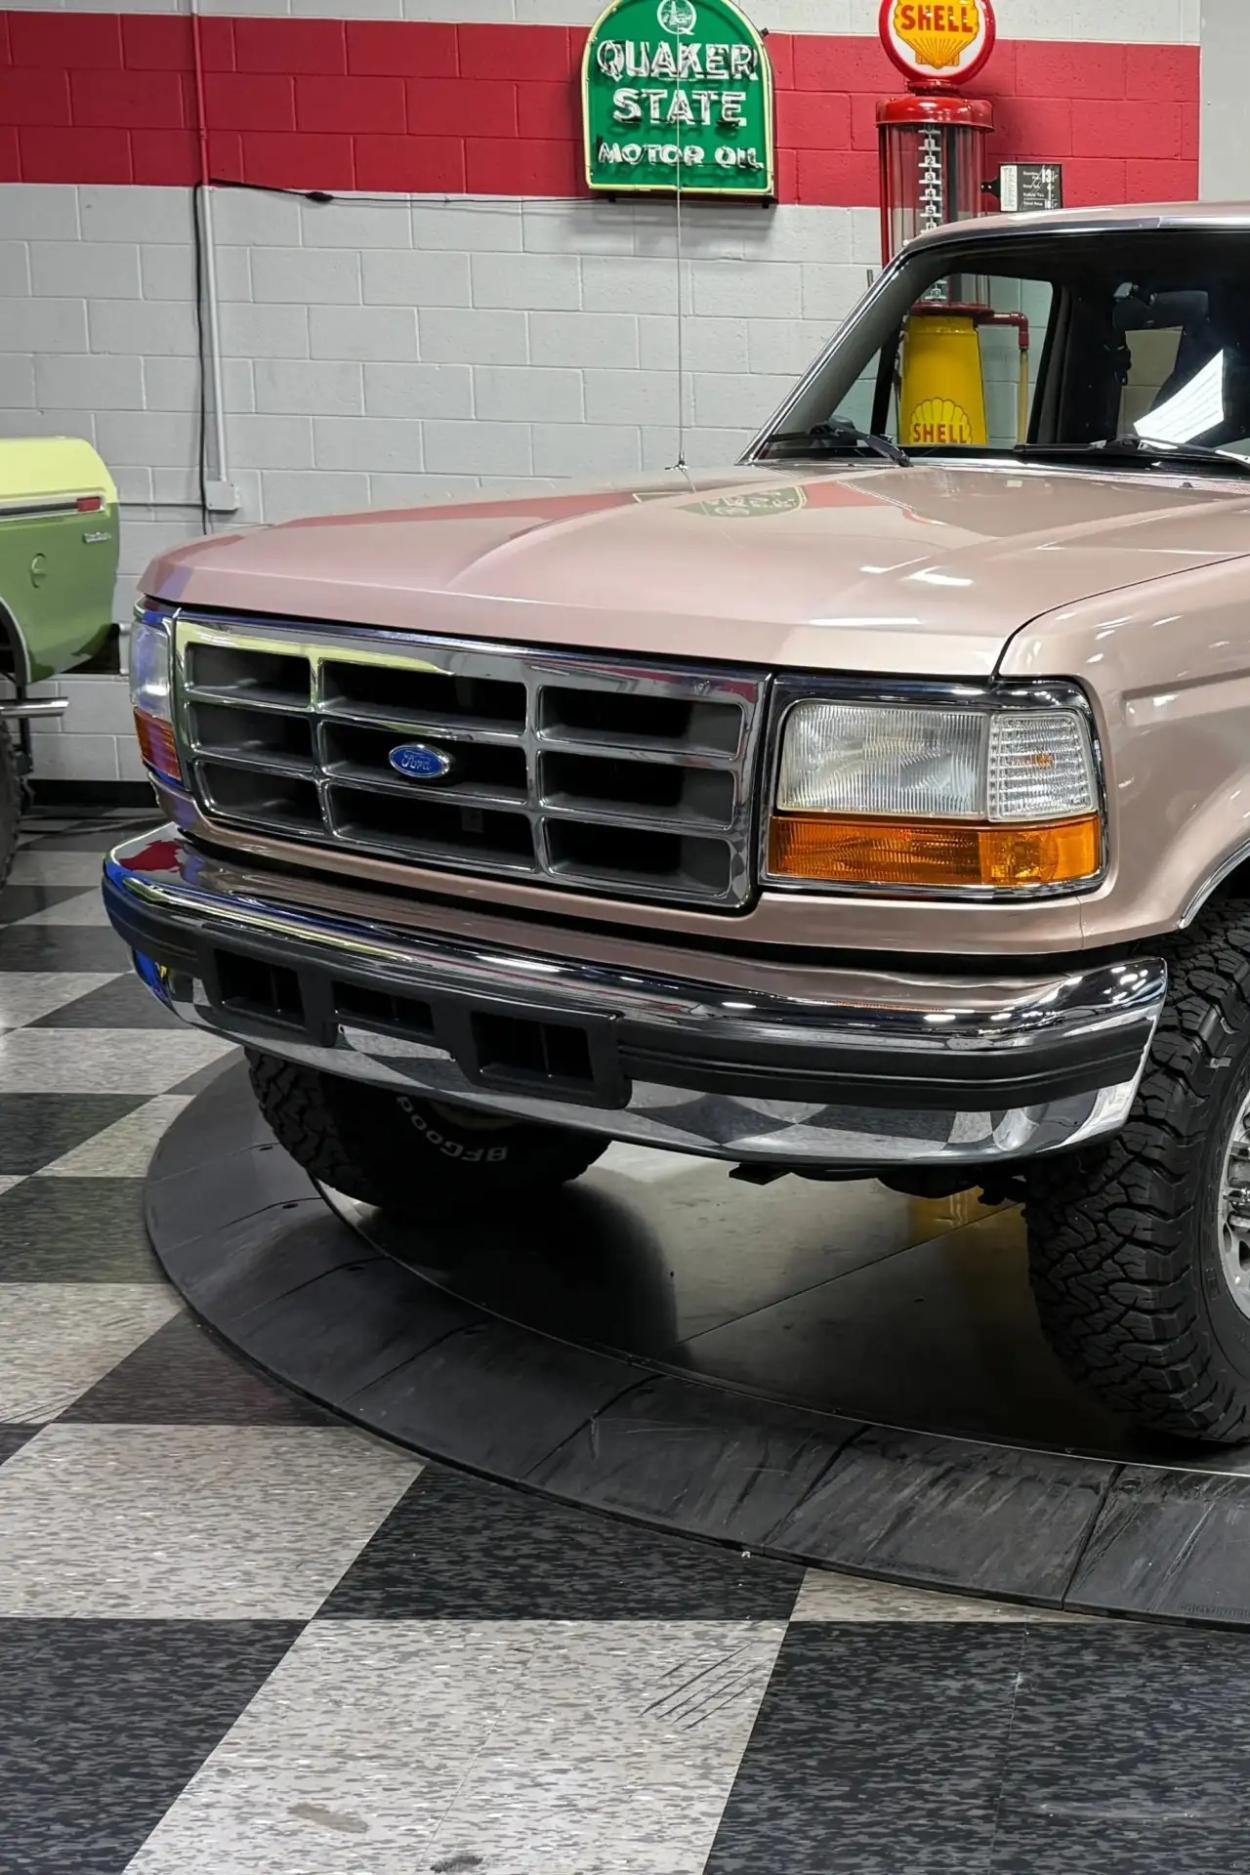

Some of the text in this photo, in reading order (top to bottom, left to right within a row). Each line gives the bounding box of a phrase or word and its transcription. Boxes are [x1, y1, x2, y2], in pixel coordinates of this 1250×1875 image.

[900, 4, 974, 33] SHELL
[596, 40, 759, 81] QUAKER
[612, 87, 748, 127] STATE
[599, 142, 764, 169] MOTOR OIL
[913, 423, 968, 443] SHELL
